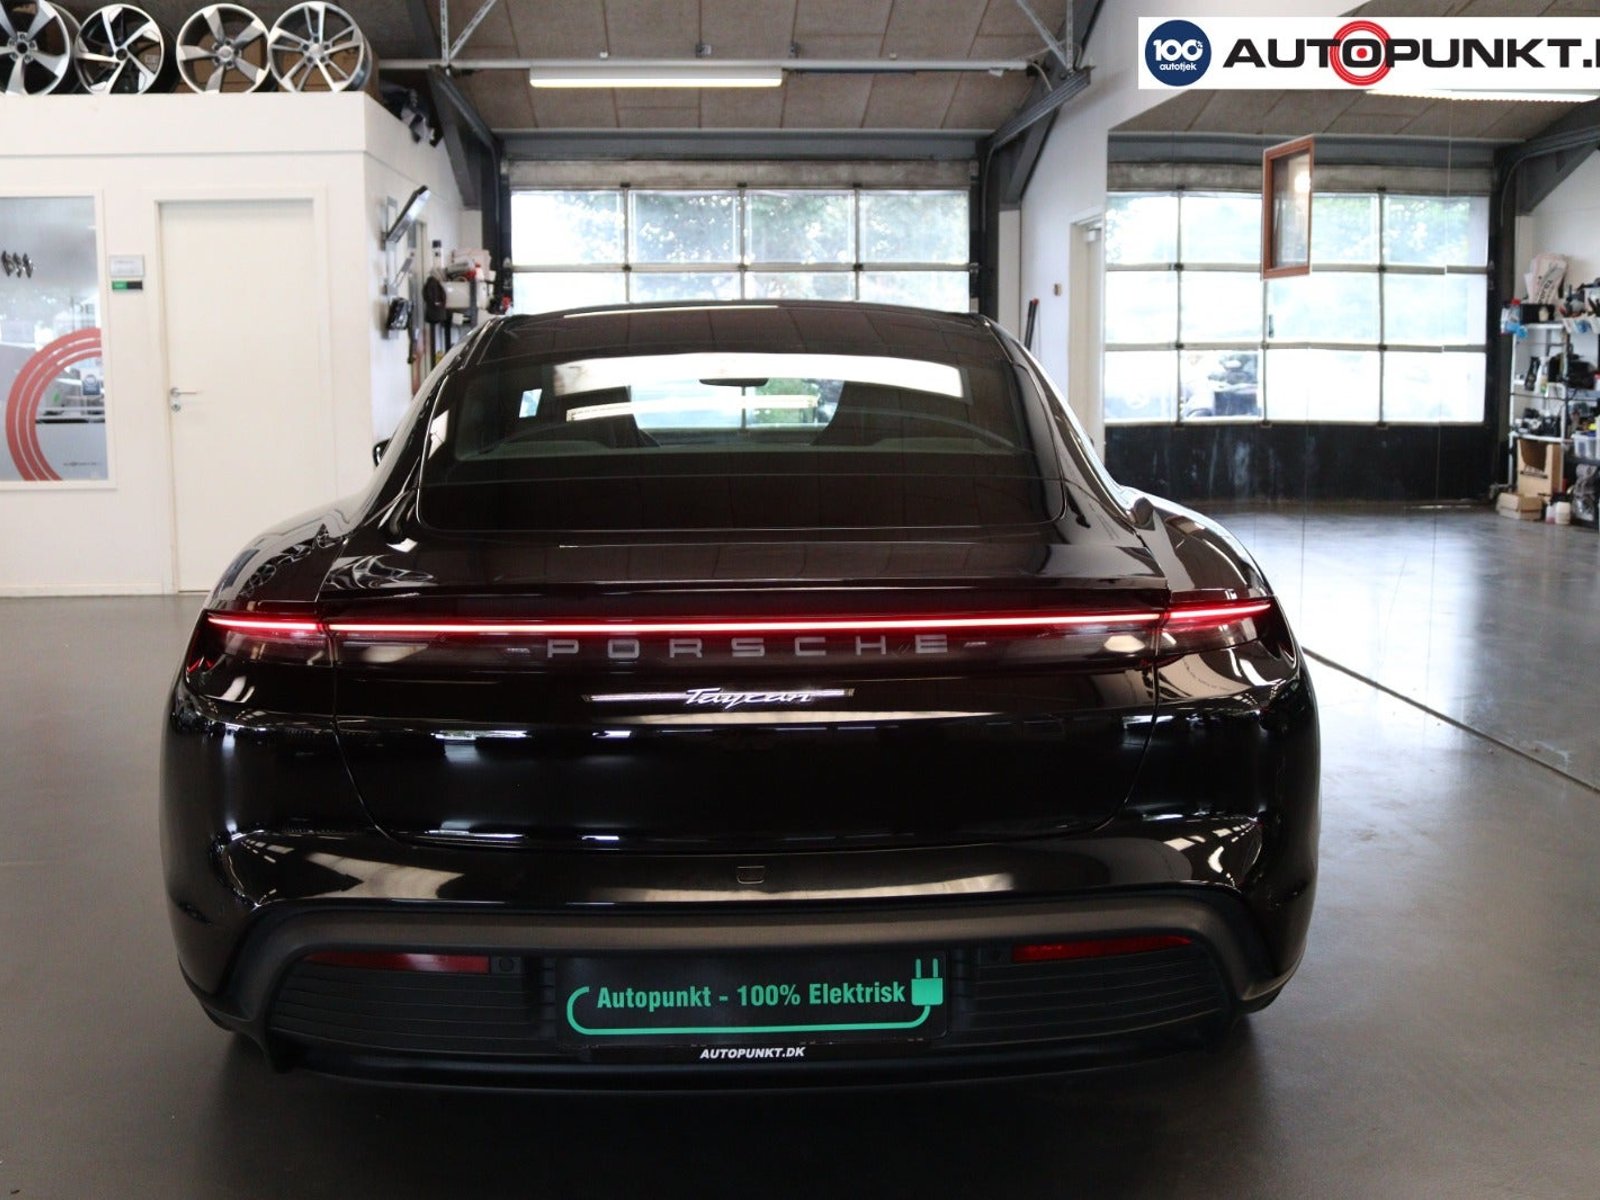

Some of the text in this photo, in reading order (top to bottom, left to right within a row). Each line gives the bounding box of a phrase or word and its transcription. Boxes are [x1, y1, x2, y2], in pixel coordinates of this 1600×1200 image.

[547, 634, 948, 659] PORSCHE
[685, 687, 811, 710] Taycan
[597, 985, 712, 1012] Autopunkt
[737, 983, 801, 1007] 100%
[809, 981, 906, 1004] Elektrisk
[699, 1046, 806, 1060] AUTOPUNKT.DK
